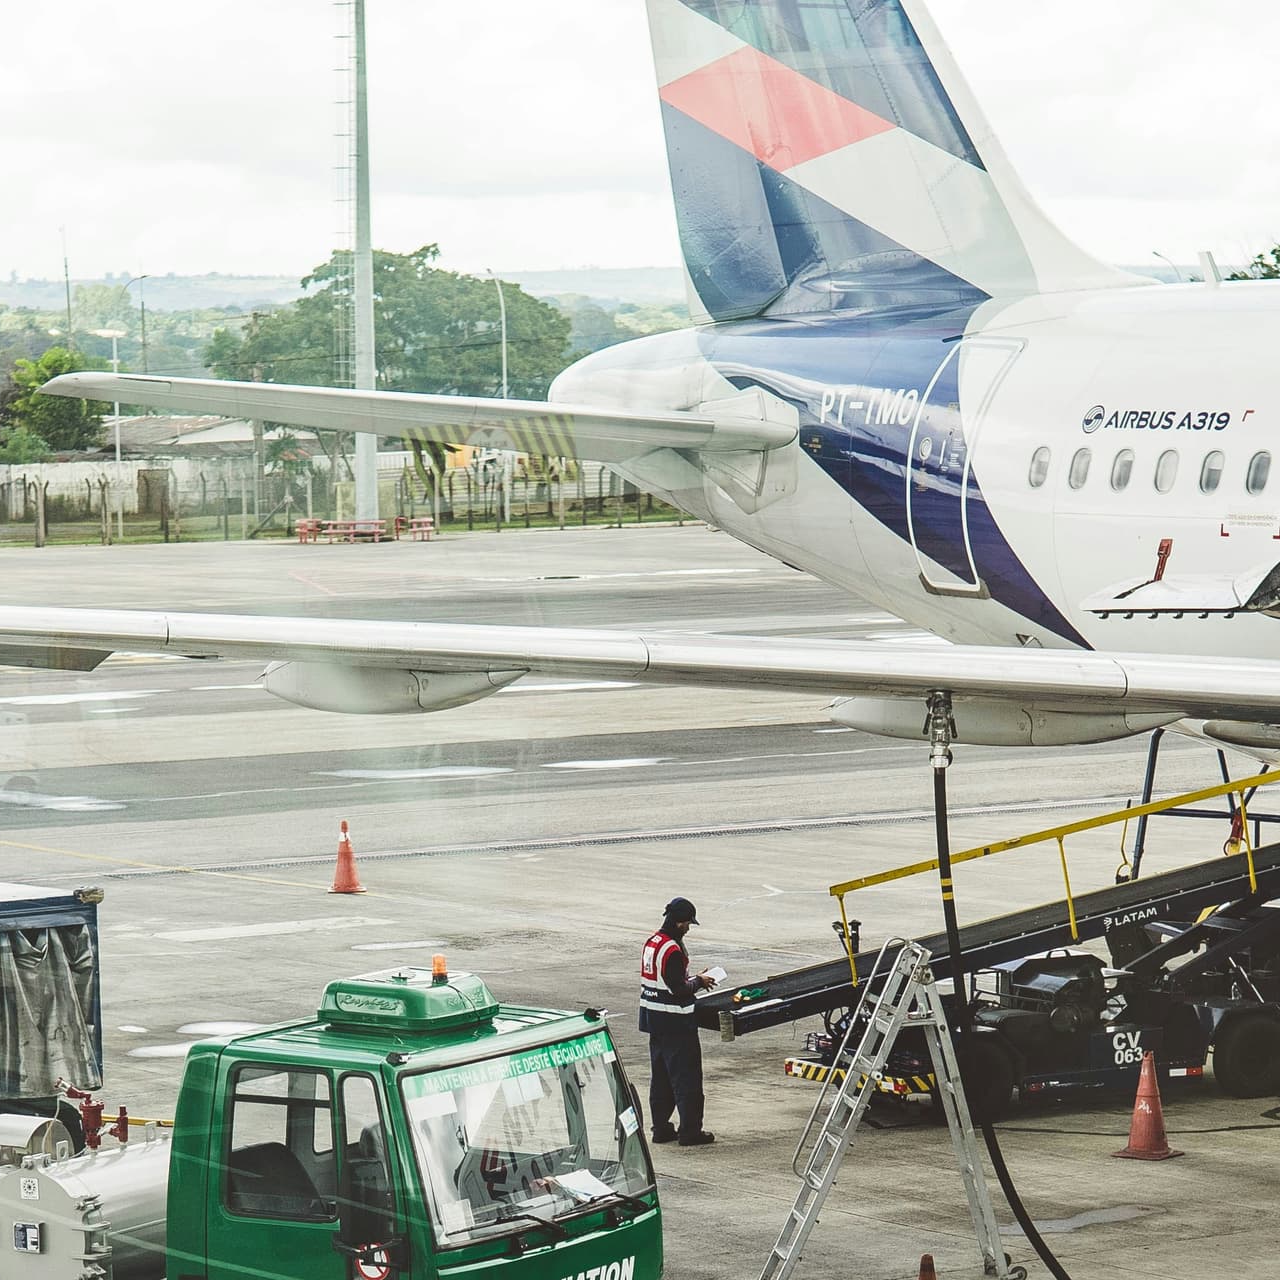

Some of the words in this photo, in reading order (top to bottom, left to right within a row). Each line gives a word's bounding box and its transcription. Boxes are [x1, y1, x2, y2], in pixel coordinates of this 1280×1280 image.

[1104, 410, 1176, 430] AIRBUS
[1176, 412, 1231, 431] A319
[1114, 907, 1158, 926] LATAM
[1112, 1030, 1141, 1050] CV
[522, 1052, 551, 1073] DESTE
[549, 1043, 583, 1067] VEÍCULO
[583, 1038, 603, 1057] LIVRE
[1114, 1046, 1144, 1065] 063
